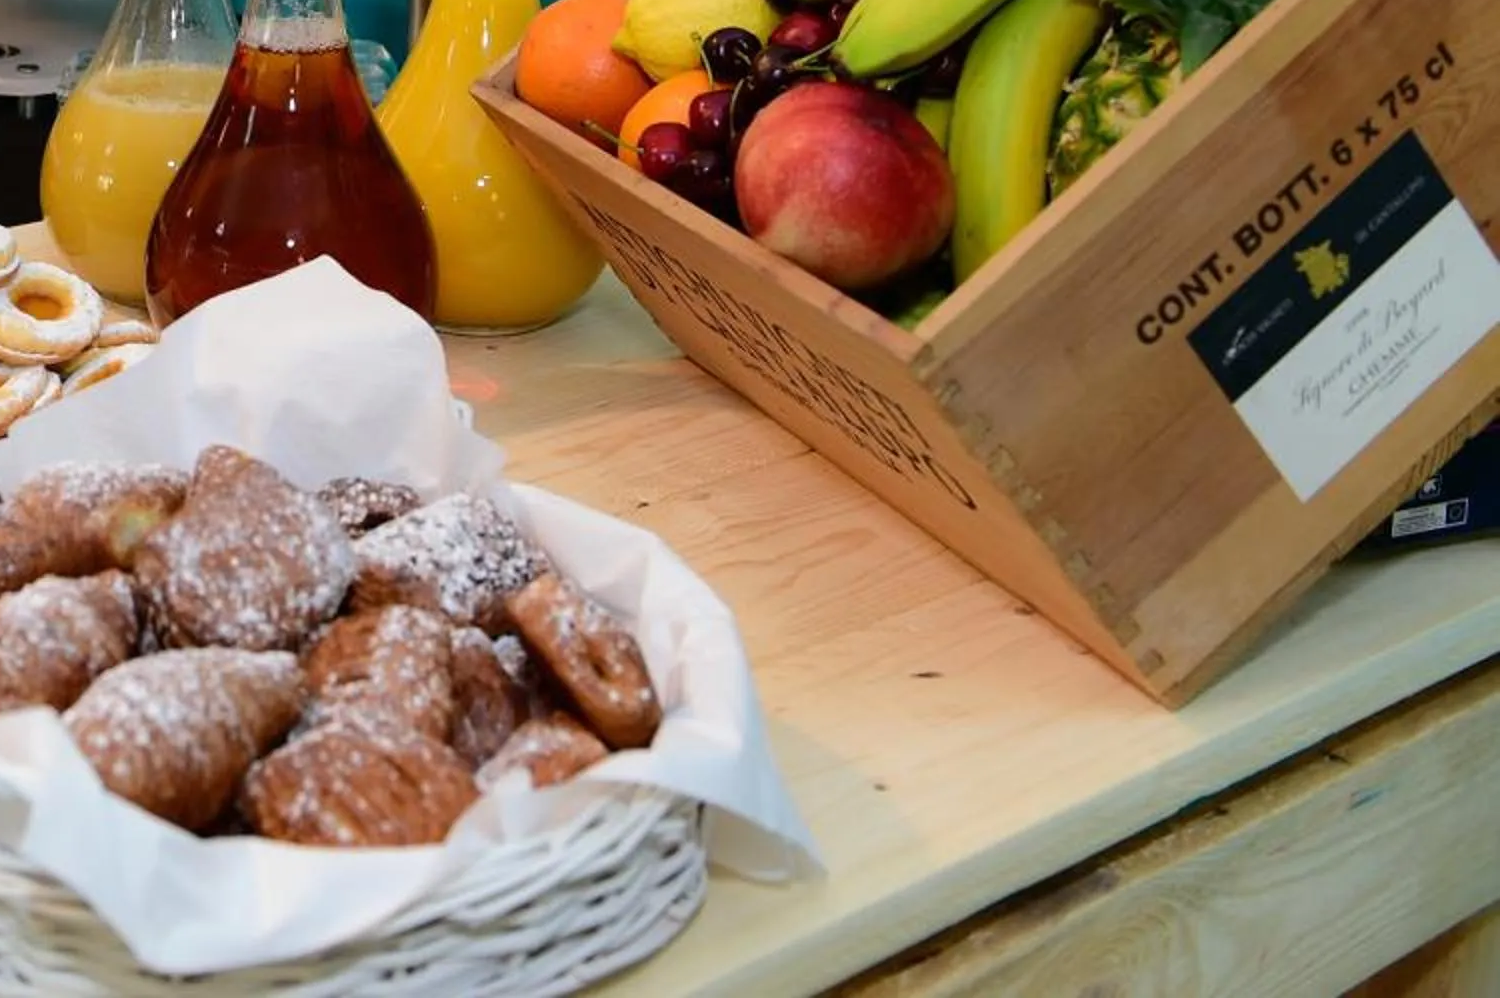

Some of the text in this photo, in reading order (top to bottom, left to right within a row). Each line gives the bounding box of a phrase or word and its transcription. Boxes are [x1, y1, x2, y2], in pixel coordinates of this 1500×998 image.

[1136, 41, 1455, 346] CONT. BOTT. 6 x 75 cl
